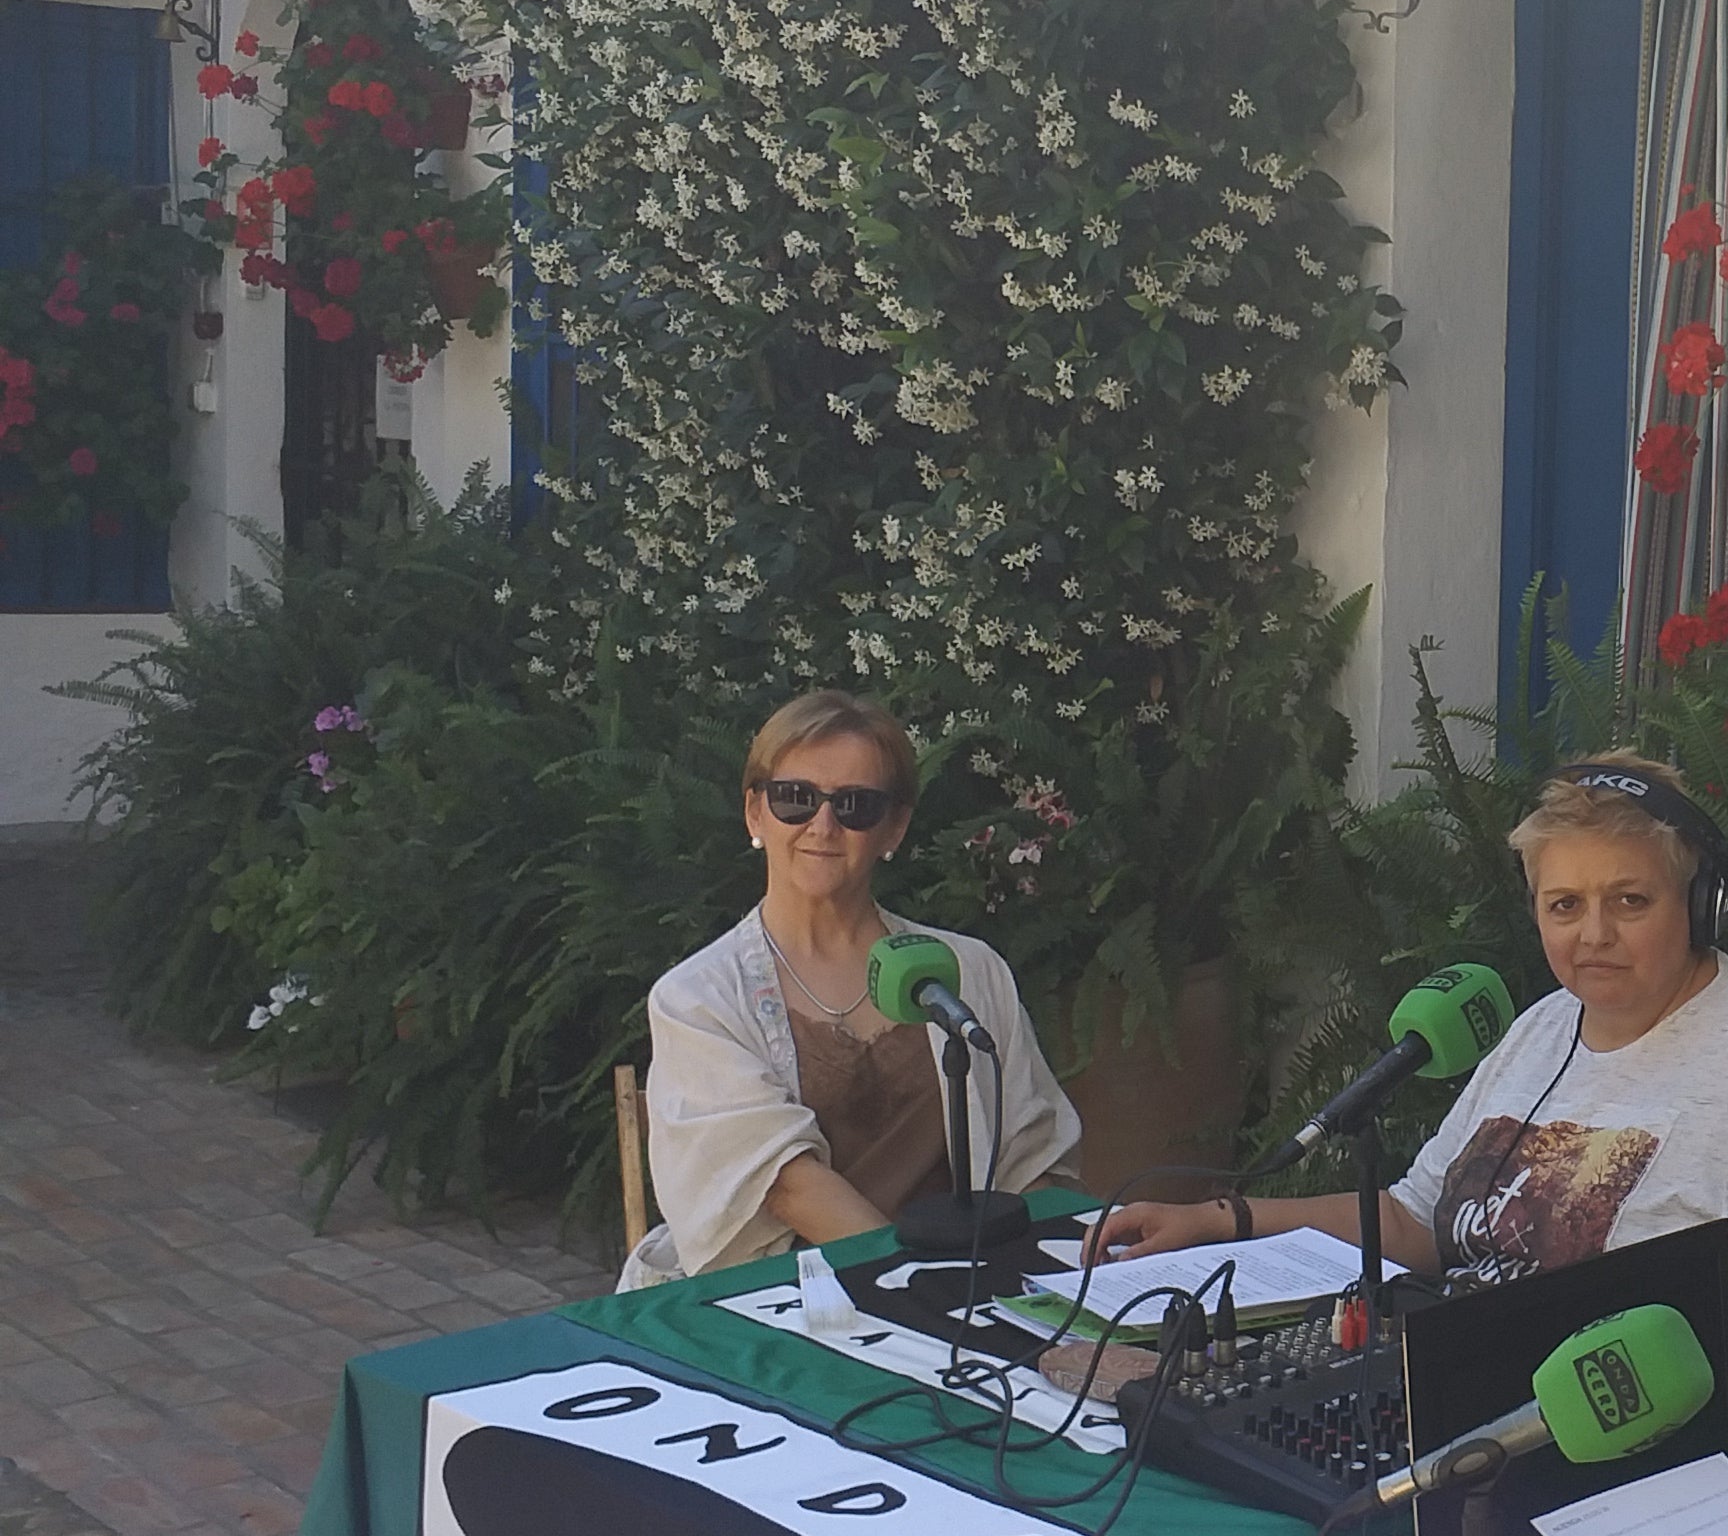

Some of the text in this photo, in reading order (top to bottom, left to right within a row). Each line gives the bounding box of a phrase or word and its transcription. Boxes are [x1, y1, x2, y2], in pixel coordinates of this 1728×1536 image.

[1575, 773, 1649, 797] AKG
[1586, 1367, 1617, 1418] CERO
[1606, 1353, 1636, 1409] ONDA
